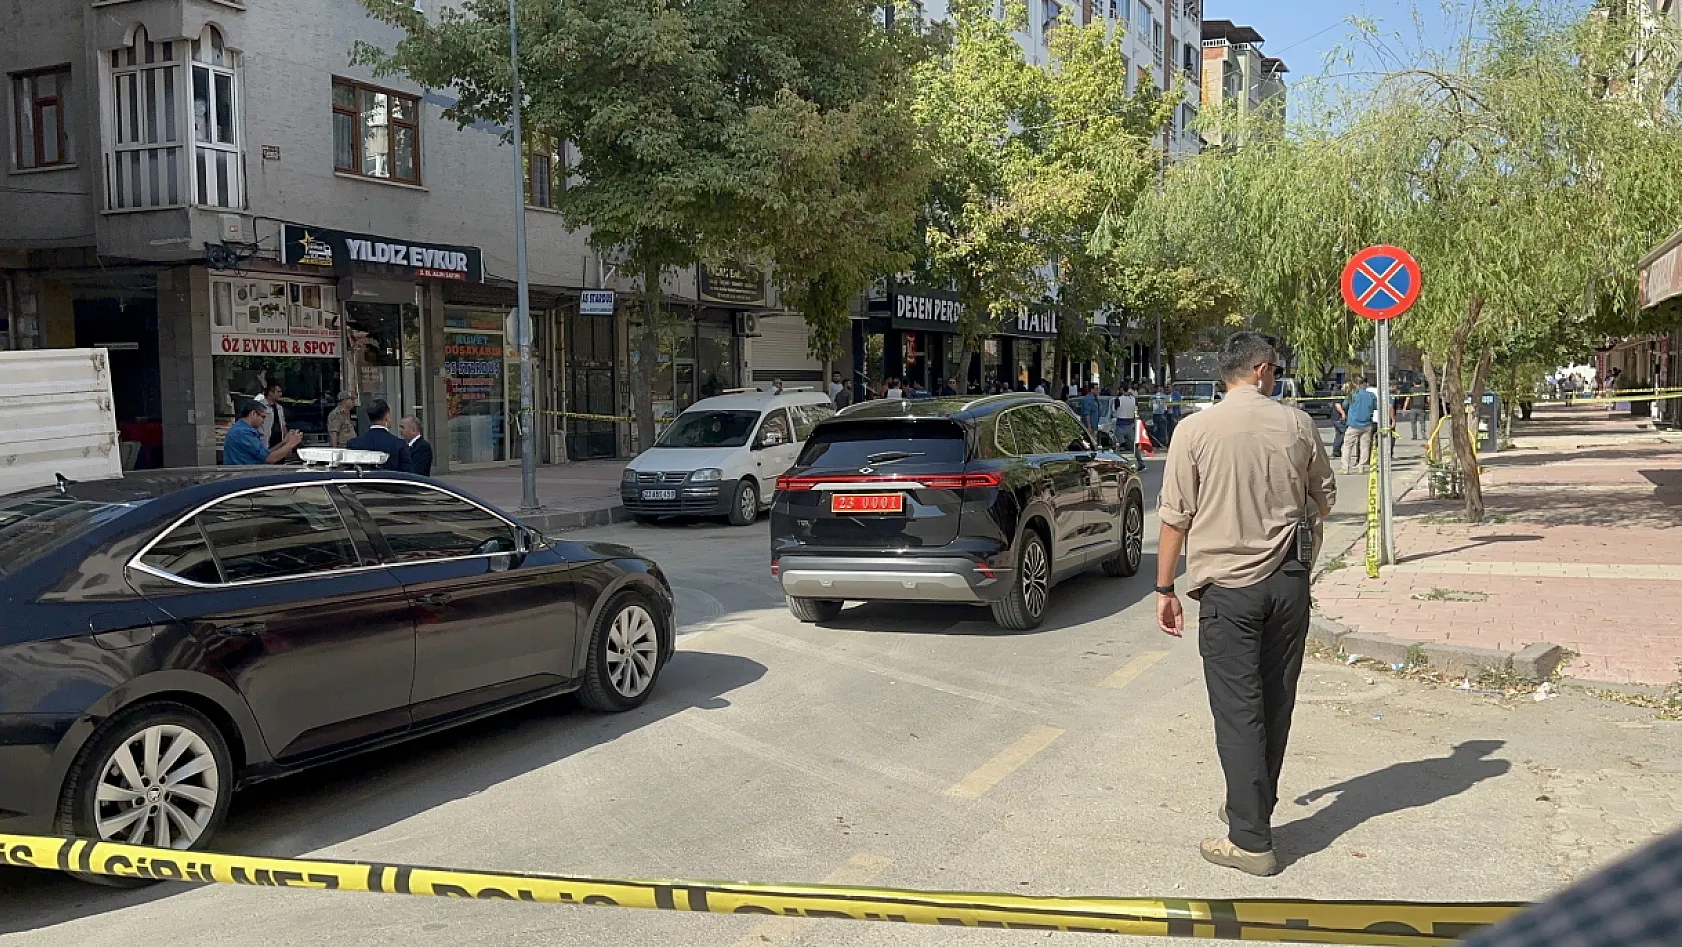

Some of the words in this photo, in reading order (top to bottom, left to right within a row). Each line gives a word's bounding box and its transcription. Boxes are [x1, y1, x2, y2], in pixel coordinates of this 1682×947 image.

[345, 238, 408, 265] YILDIZ
[409, 246, 468, 272] EVKUR
[221, 334, 240, 353] ÖZ
[242, 338, 288, 353] EVKUR
[292, 340, 301, 354] &
[303, 341, 336, 355] SPOT
[839, 497, 855, 509] 23
[861, 496, 896, 508] 0001
